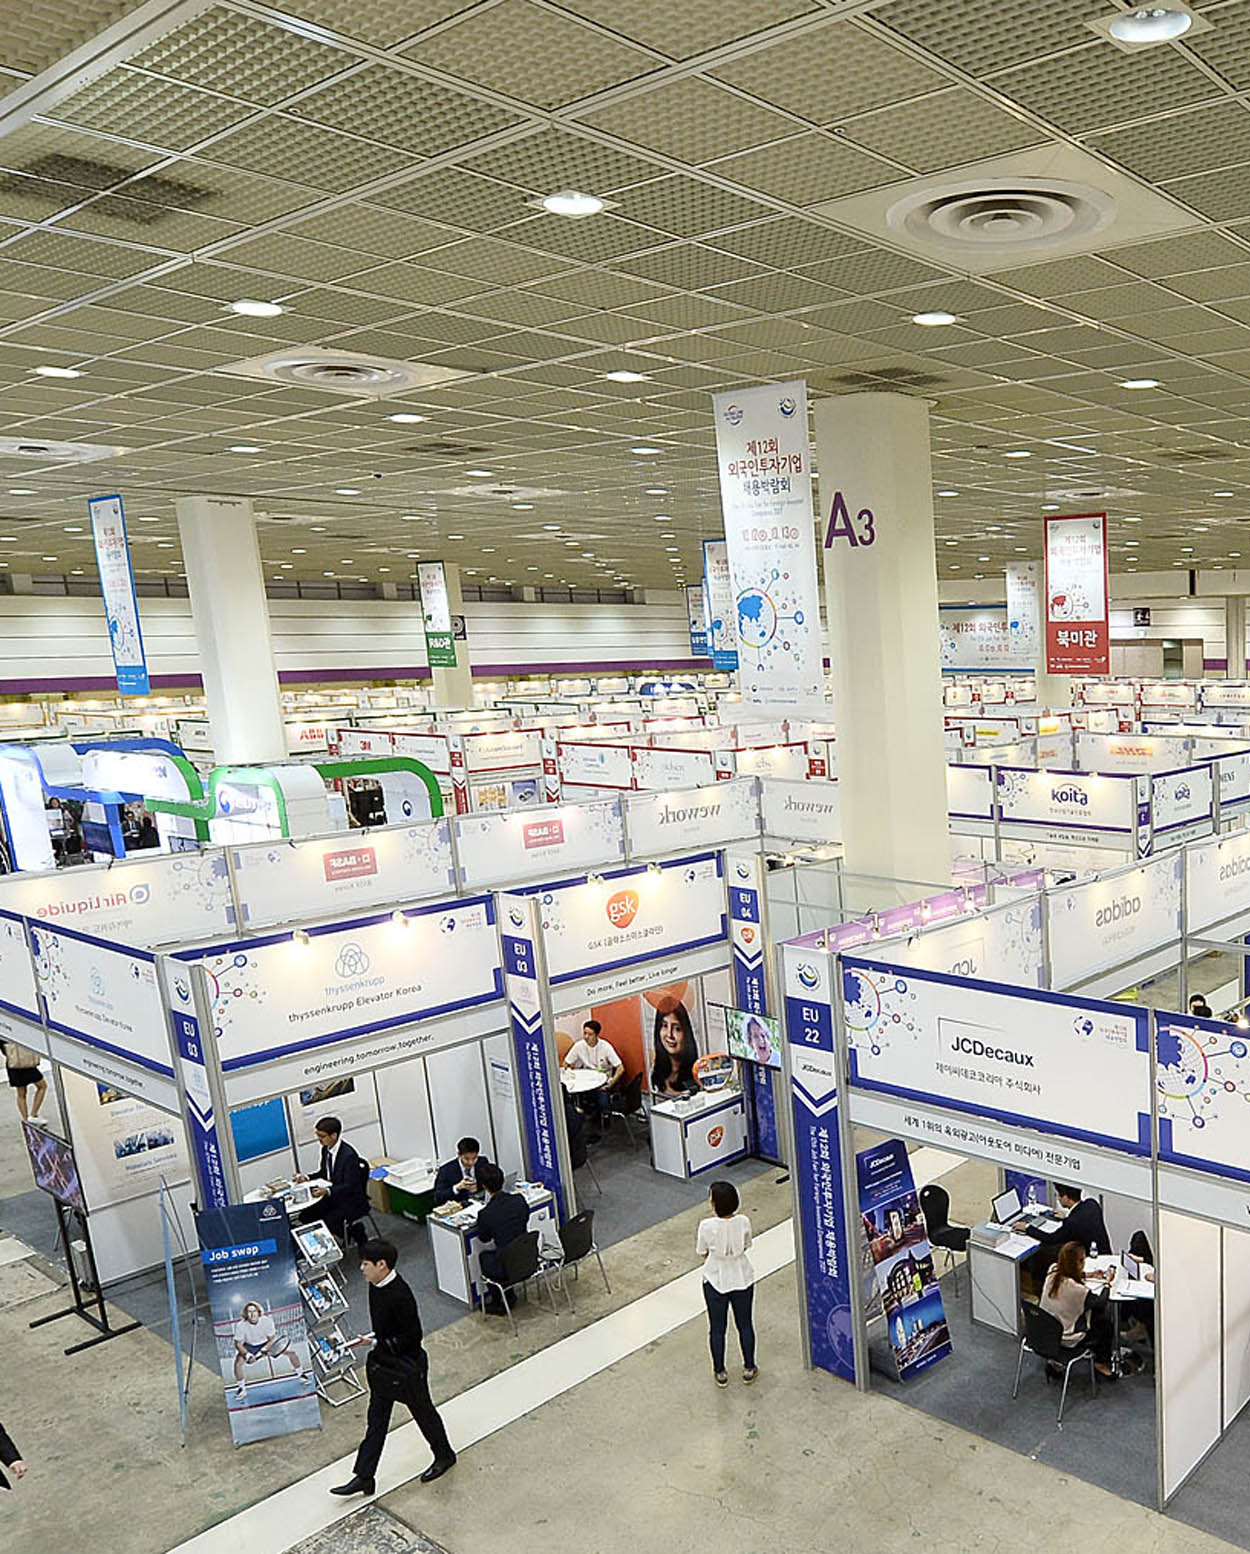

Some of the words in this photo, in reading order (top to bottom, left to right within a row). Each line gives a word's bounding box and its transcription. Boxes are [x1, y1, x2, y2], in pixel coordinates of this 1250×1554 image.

[747, 437, 779, 456] 제12회
[728, 453, 802, 479] 외국인투자기업
[825, 492, 876, 549] A3
[1056, 629, 1098, 648] 북미관
[1051, 787, 1089, 806] koita
[740, 893, 752, 904] EU
[609, 896, 636, 923] gsk
[514, 942, 526, 956] EU
[325, 976, 385, 996] thyssenkrupp
[288, 1001, 354, 1022] thyssenkrupp
[356, 992, 394, 1006] Elevator
[396, 985, 422, 996] Korea
[802, 1006, 819, 1023] EU
[804, 1027, 821, 1044] 22
[951, 1036, 1035, 1067] JCDecaux
[1006, 1078, 1042, 1096] 주식회사
[209, 1249, 229, 1261] Job
[231, 1245, 259, 1258] swap
